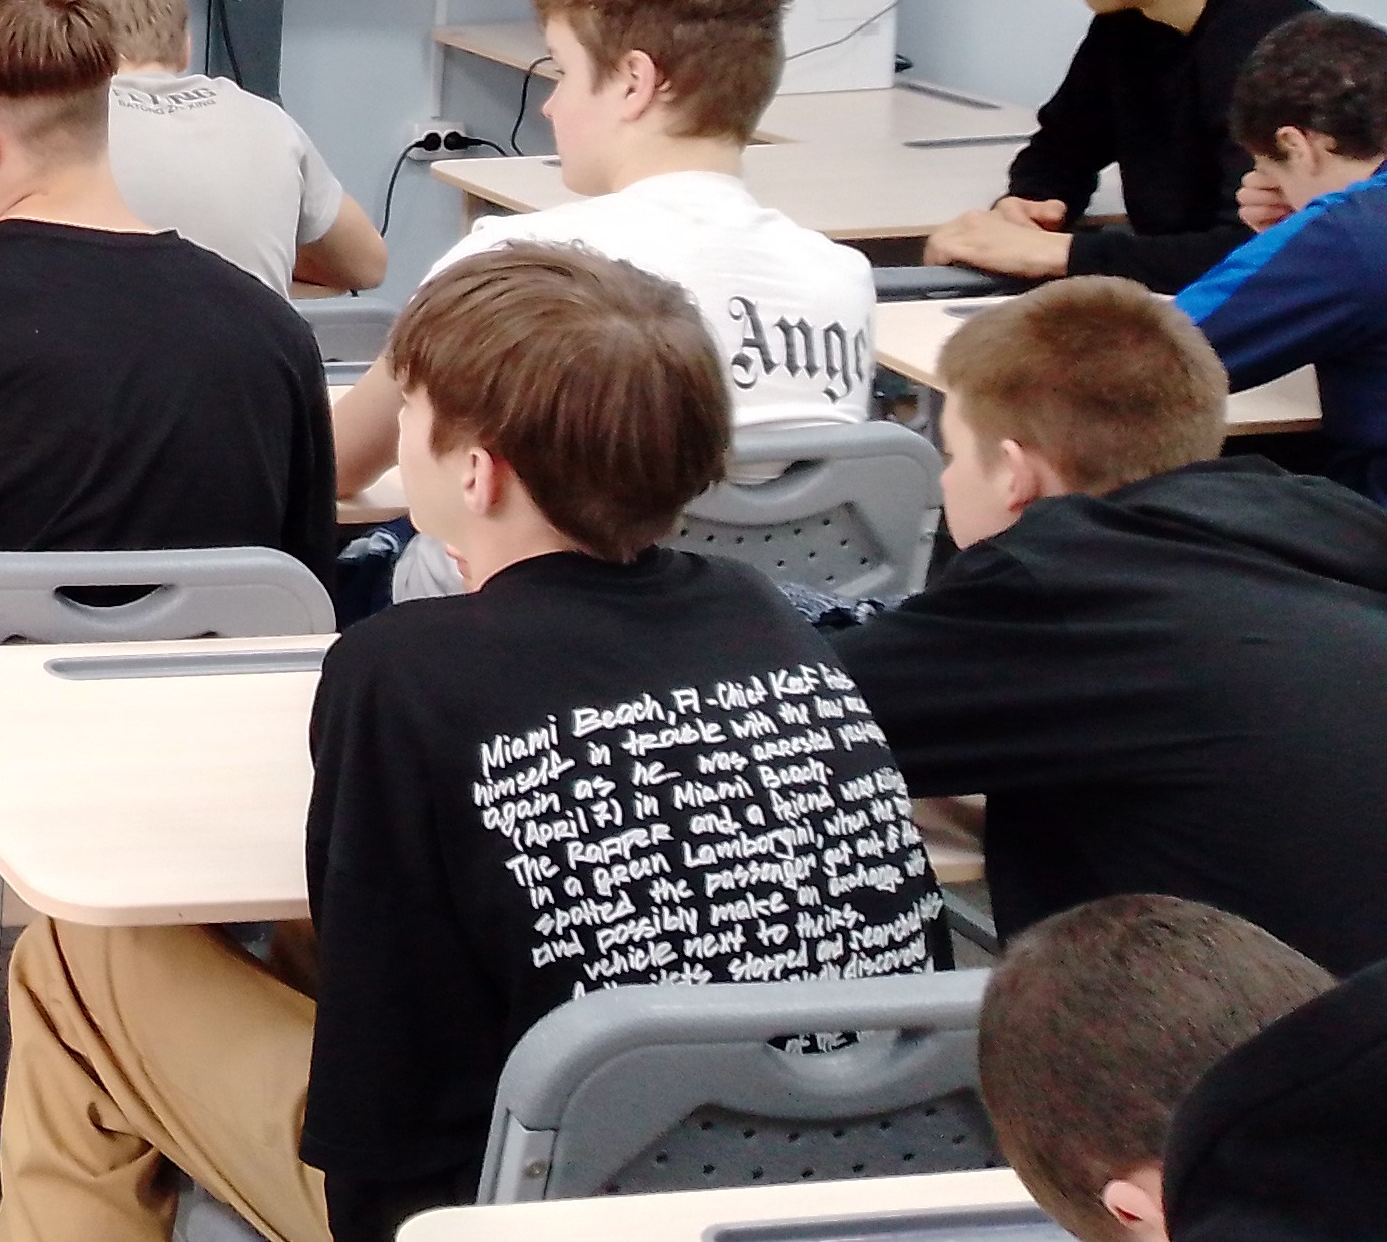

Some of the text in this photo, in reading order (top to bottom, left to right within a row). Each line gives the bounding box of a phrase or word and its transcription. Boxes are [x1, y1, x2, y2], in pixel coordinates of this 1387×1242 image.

[473, 749, 576, 807] himself
[586, 740, 613, 767] in
[729, 710, 780, 740] with
[480, 714, 559, 779] Miami
[572, 692, 677, 738] Beach,
[482, 790, 561, 838] again
[575, 775, 617, 801] as
[631, 761, 682, 787] he
[697, 749, 750, 775] was
[634, 791, 660, 820] in
[673, 774, 755, 811] Miami
[505, 854, 561, 888] The
[689, 804, 742, 836] and
[746, 804, 767, 827] a
[529, 885, 555, 910] in
[563, 876, 585, 898] a
[531, 929, 585, 968] and
[595, 906, 700, 956] possibly
[709, 891, 790, 927] make
[796, 885, 822, 907] an
[533, 889, 637, 937] spotted
[648, 876, 696, 905] the
[704, 853, 817, 899] passenger
[583, 941, 679, 981] vehicle
[683, 923, 746, 959] next
[756, 919, 789, 947] to
[727, 939, 810, 981] stopped
